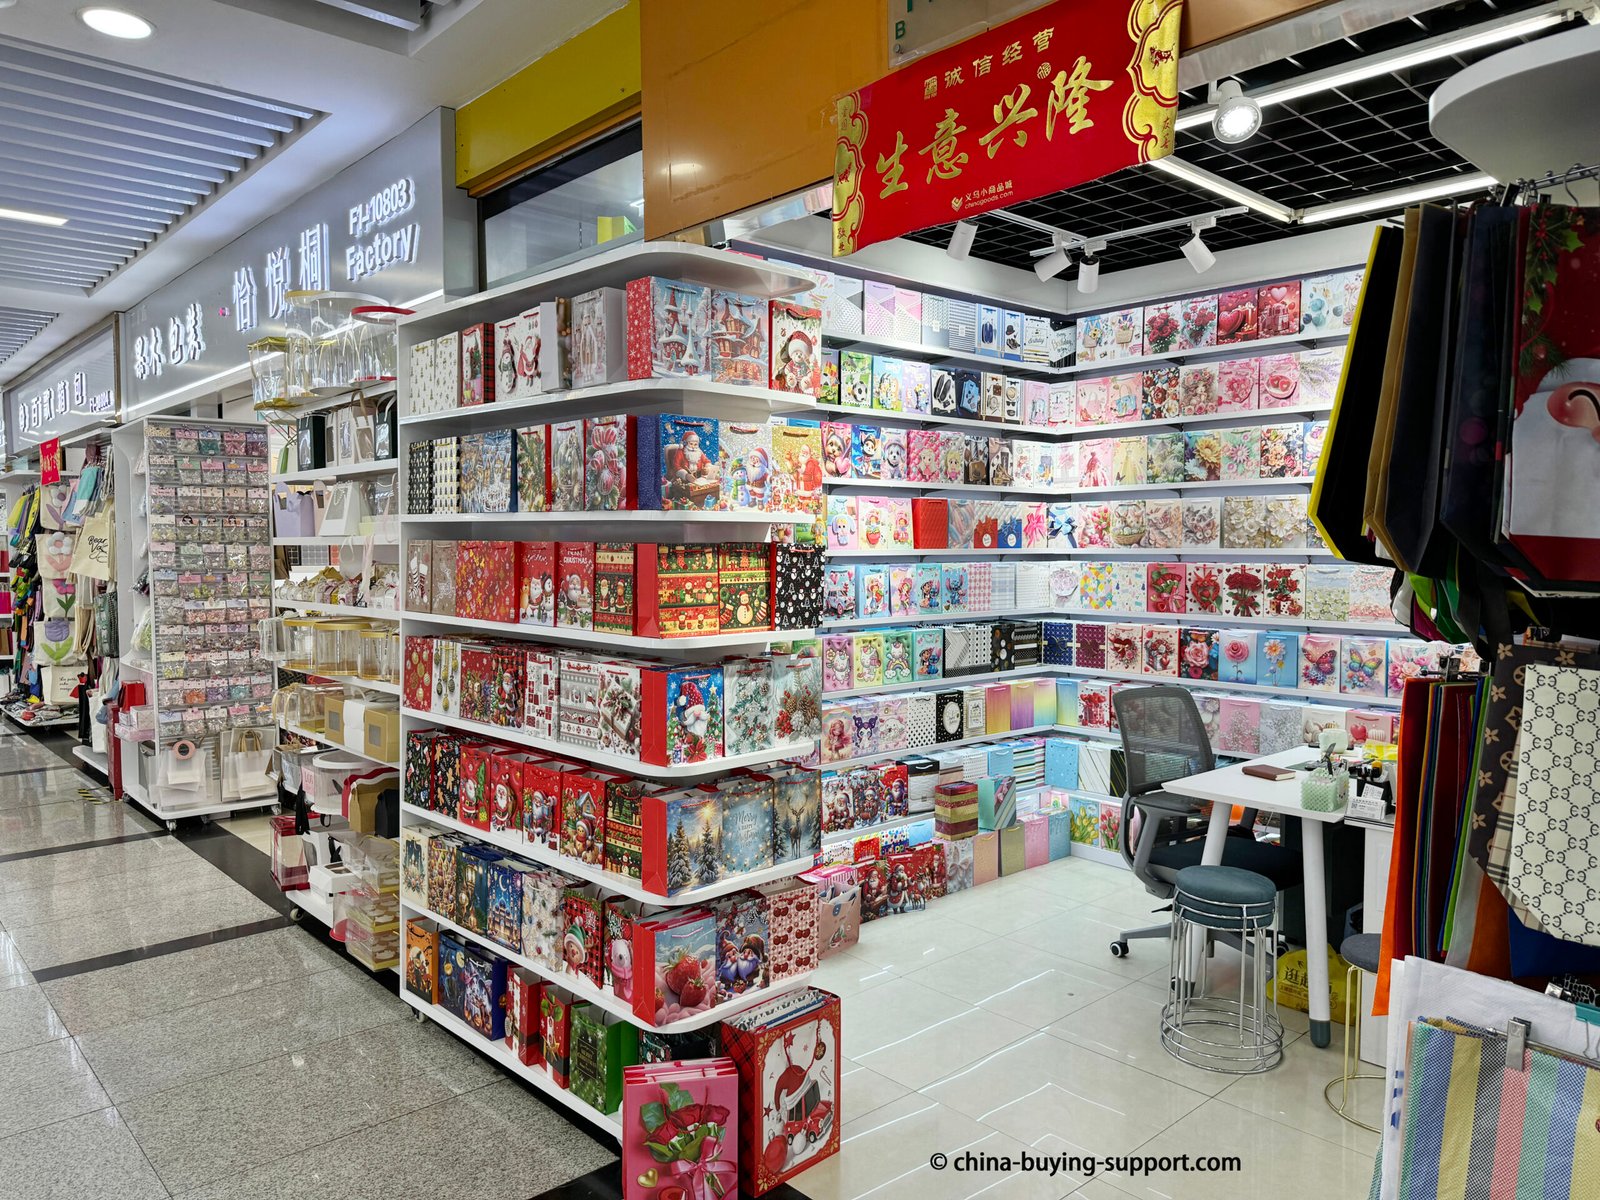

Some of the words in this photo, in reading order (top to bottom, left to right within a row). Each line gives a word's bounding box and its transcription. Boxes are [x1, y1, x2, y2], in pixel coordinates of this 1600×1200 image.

[895, 20, 906, 40] B
[944, 27, 1055, 89] 诚信经营
[876, 55, 1115, 200] 生意兴隆
[349, 177, 413, 236] F1-10803
[965, 180, 1013, 202] 义乌小商品城
[346, 223, 418, 281] Factory
